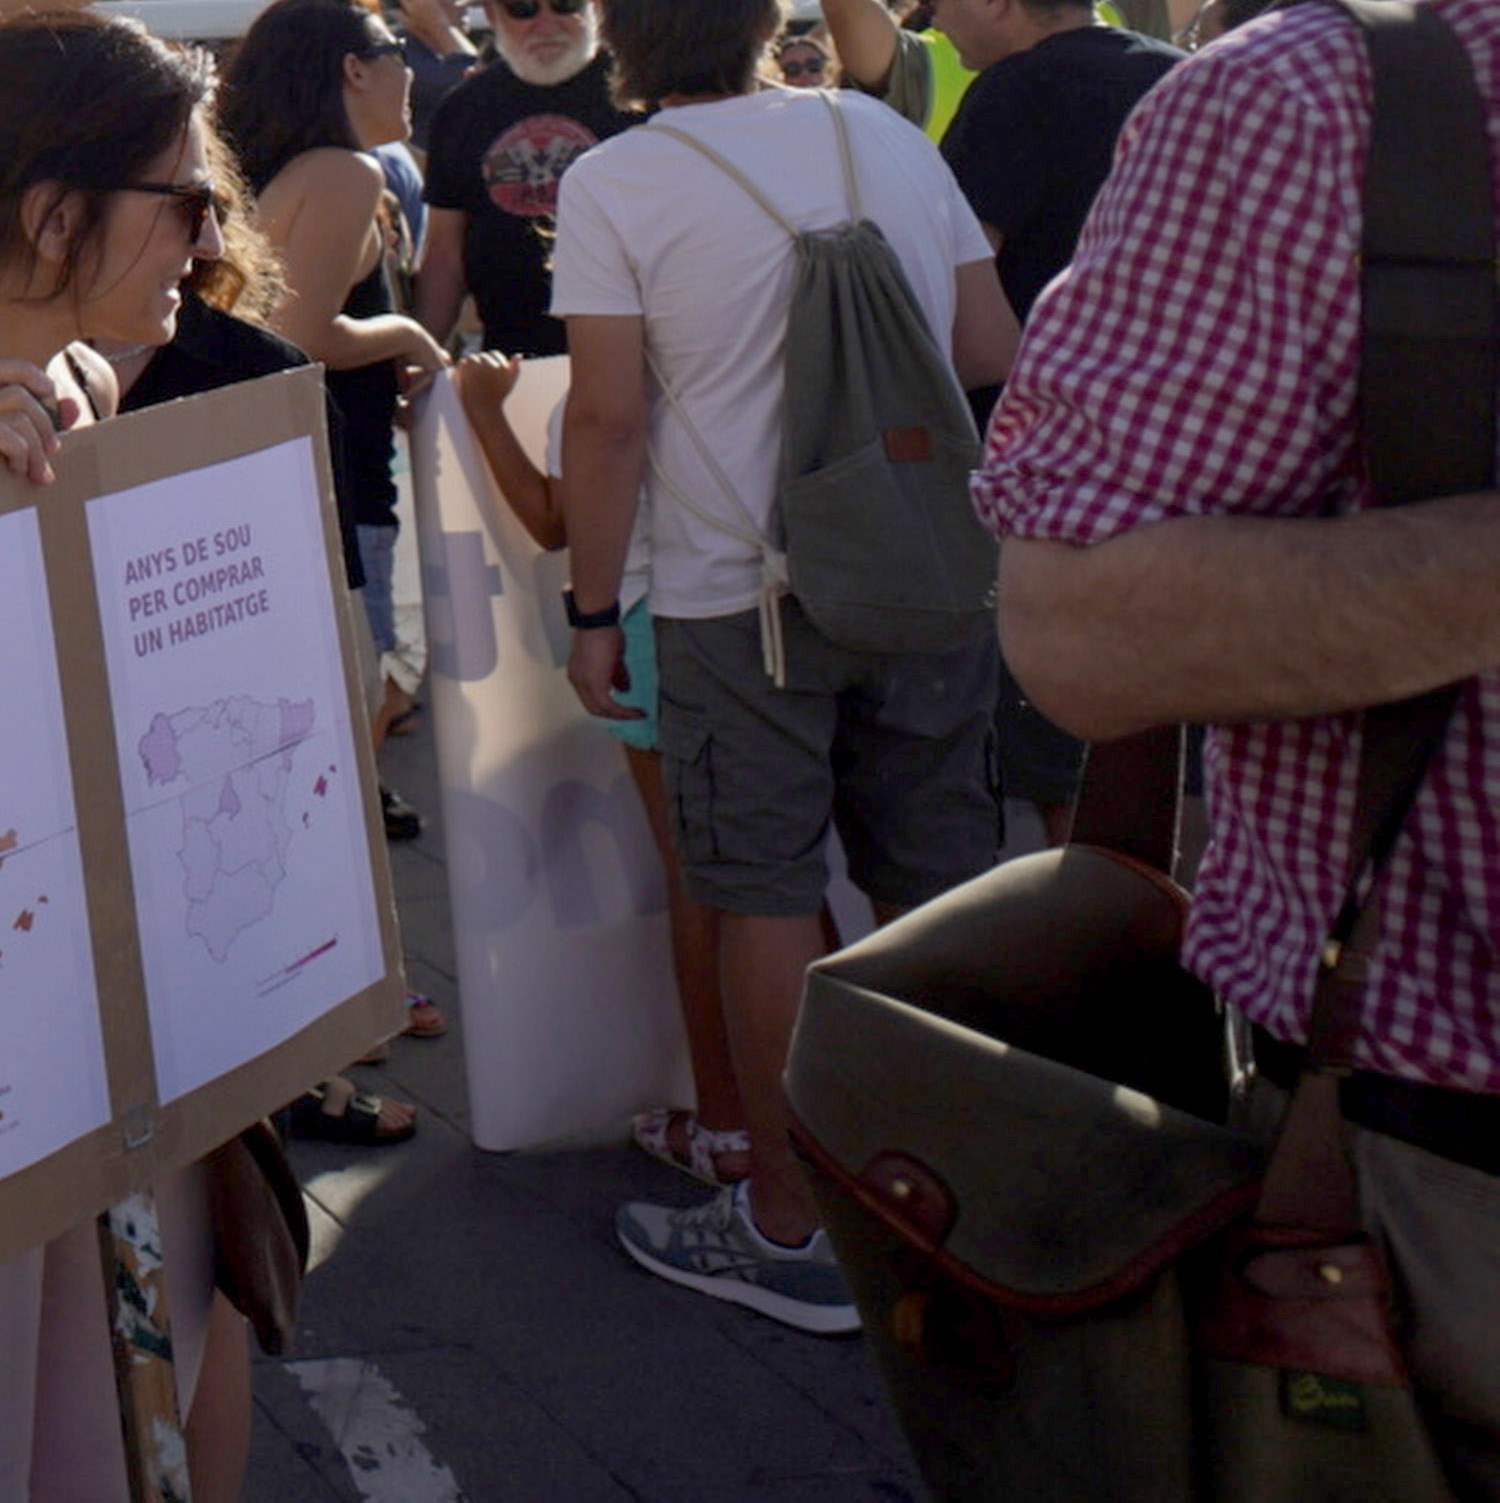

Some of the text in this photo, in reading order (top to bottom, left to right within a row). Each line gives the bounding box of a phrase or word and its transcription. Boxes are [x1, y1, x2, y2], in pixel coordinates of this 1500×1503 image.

[125, 523, 251, 585] ANYS DE SOU
[129, 555, 265, 621] PER COMPRAR
[133, 589, 270, 658] UN HABITATGE
